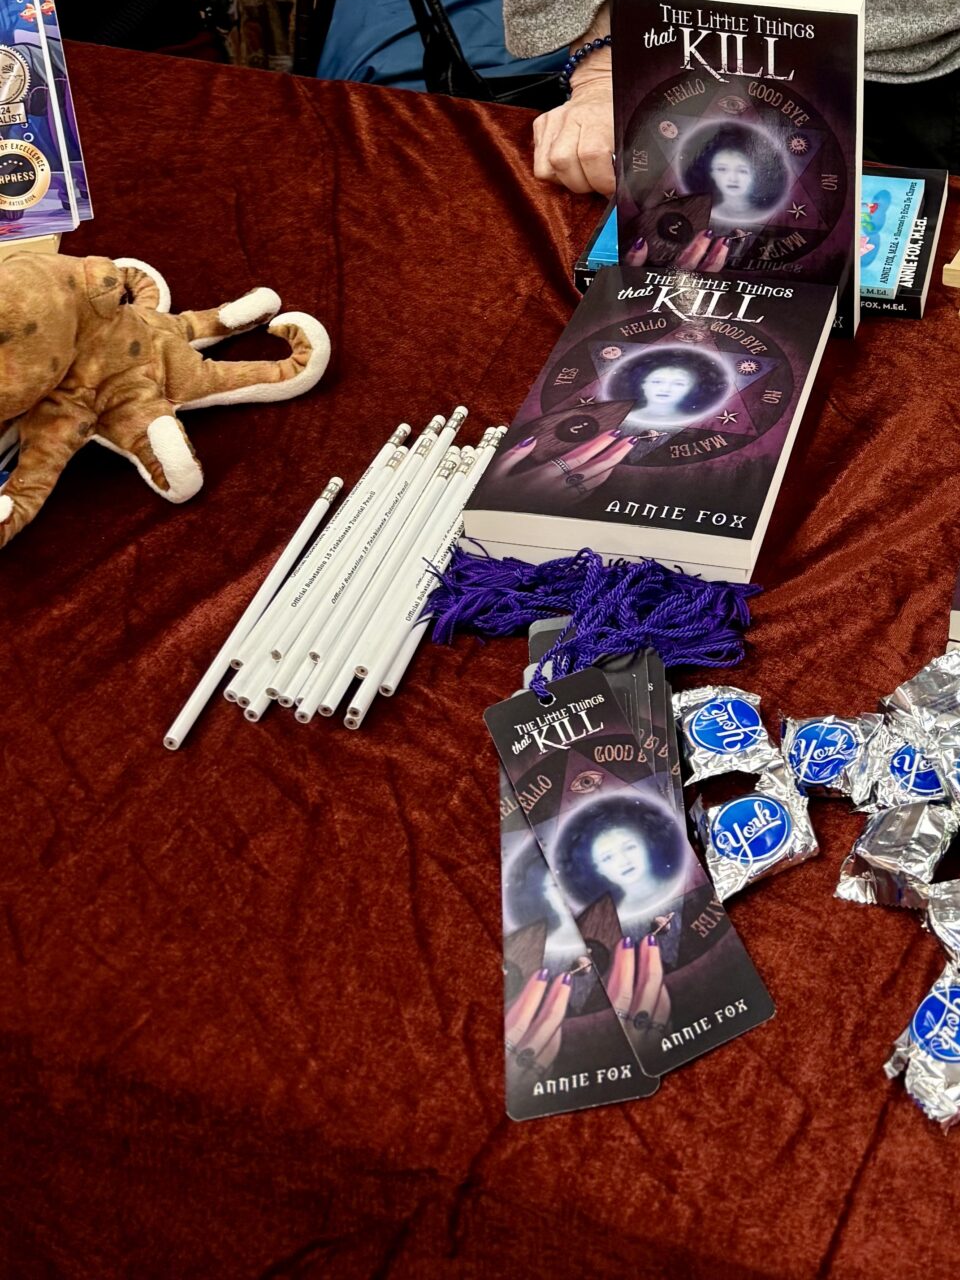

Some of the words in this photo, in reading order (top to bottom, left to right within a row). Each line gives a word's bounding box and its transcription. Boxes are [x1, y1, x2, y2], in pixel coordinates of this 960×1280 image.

[659, 2, 693, 26] THE
[643, 25, 677, 49] that
[678, 26, 796, 84] KILL
[663, 77, 706, 107] HELLO
[747, 80, 784, 108] GOOD
[780, 100, 810, 128] BYE
[10, 142, 46, 168] EXCELLENCE
[632, 149, 650, 176] YES
[820, 173, 840, 192] NO
[911, 216, 929, 239] M.Ed.
[905, 237, 925, 261] FOX,
[644, 271, 676, 287] THE
[879, 263, 893, 285] ANNIE
[898, 258, 919, 289] ANNIE
[617, 285, 655, 300] that
[647, 286, 766, 325] KILL
[860, 300, 882, 311] FOX,
[882, 302, 908, 312] M.Ed.
[619, 317, 668, 338] HELLO
[710, 320, 744, 339] GOOD
[740, 334, 769, 356] BYE
[552, 366, 580, 388] YES
[760, 389, 784, 406] NO
[669, 433, 729, 459] MAYBE
[384, 495, 400, 519] Tutorial
[396, 479, 410, 498] Pencil
[604, 499, 688, 521] ANNIE
[694, 508, 748, 530] FOX
[291, 587, 308, 609] Official
[304, 560, 328, 589] Substation
[348, 504, 366, 527] Tutorial
[362, 489, 377, 507] Pencil
[405, 600, 421, 623] Official
[416, 575, 436, 603] Substatio
[511, 735, 533, 756] that
[531, 709, 606, 756] KILL
[513, 720, 534, 737] THE
[699, 701, 769, 752] York
[594, 744, 635, 764] GOOD
[791, 732, 853, 784] York
[715, 800, 783, 867] York
[660, 1016, 713, 1053] ANNIE
[714, 997, 750, 1025] FOX
[532, 1071, 591, 1097] ANNIE
[595, 1064, 634, 1085] FOX
